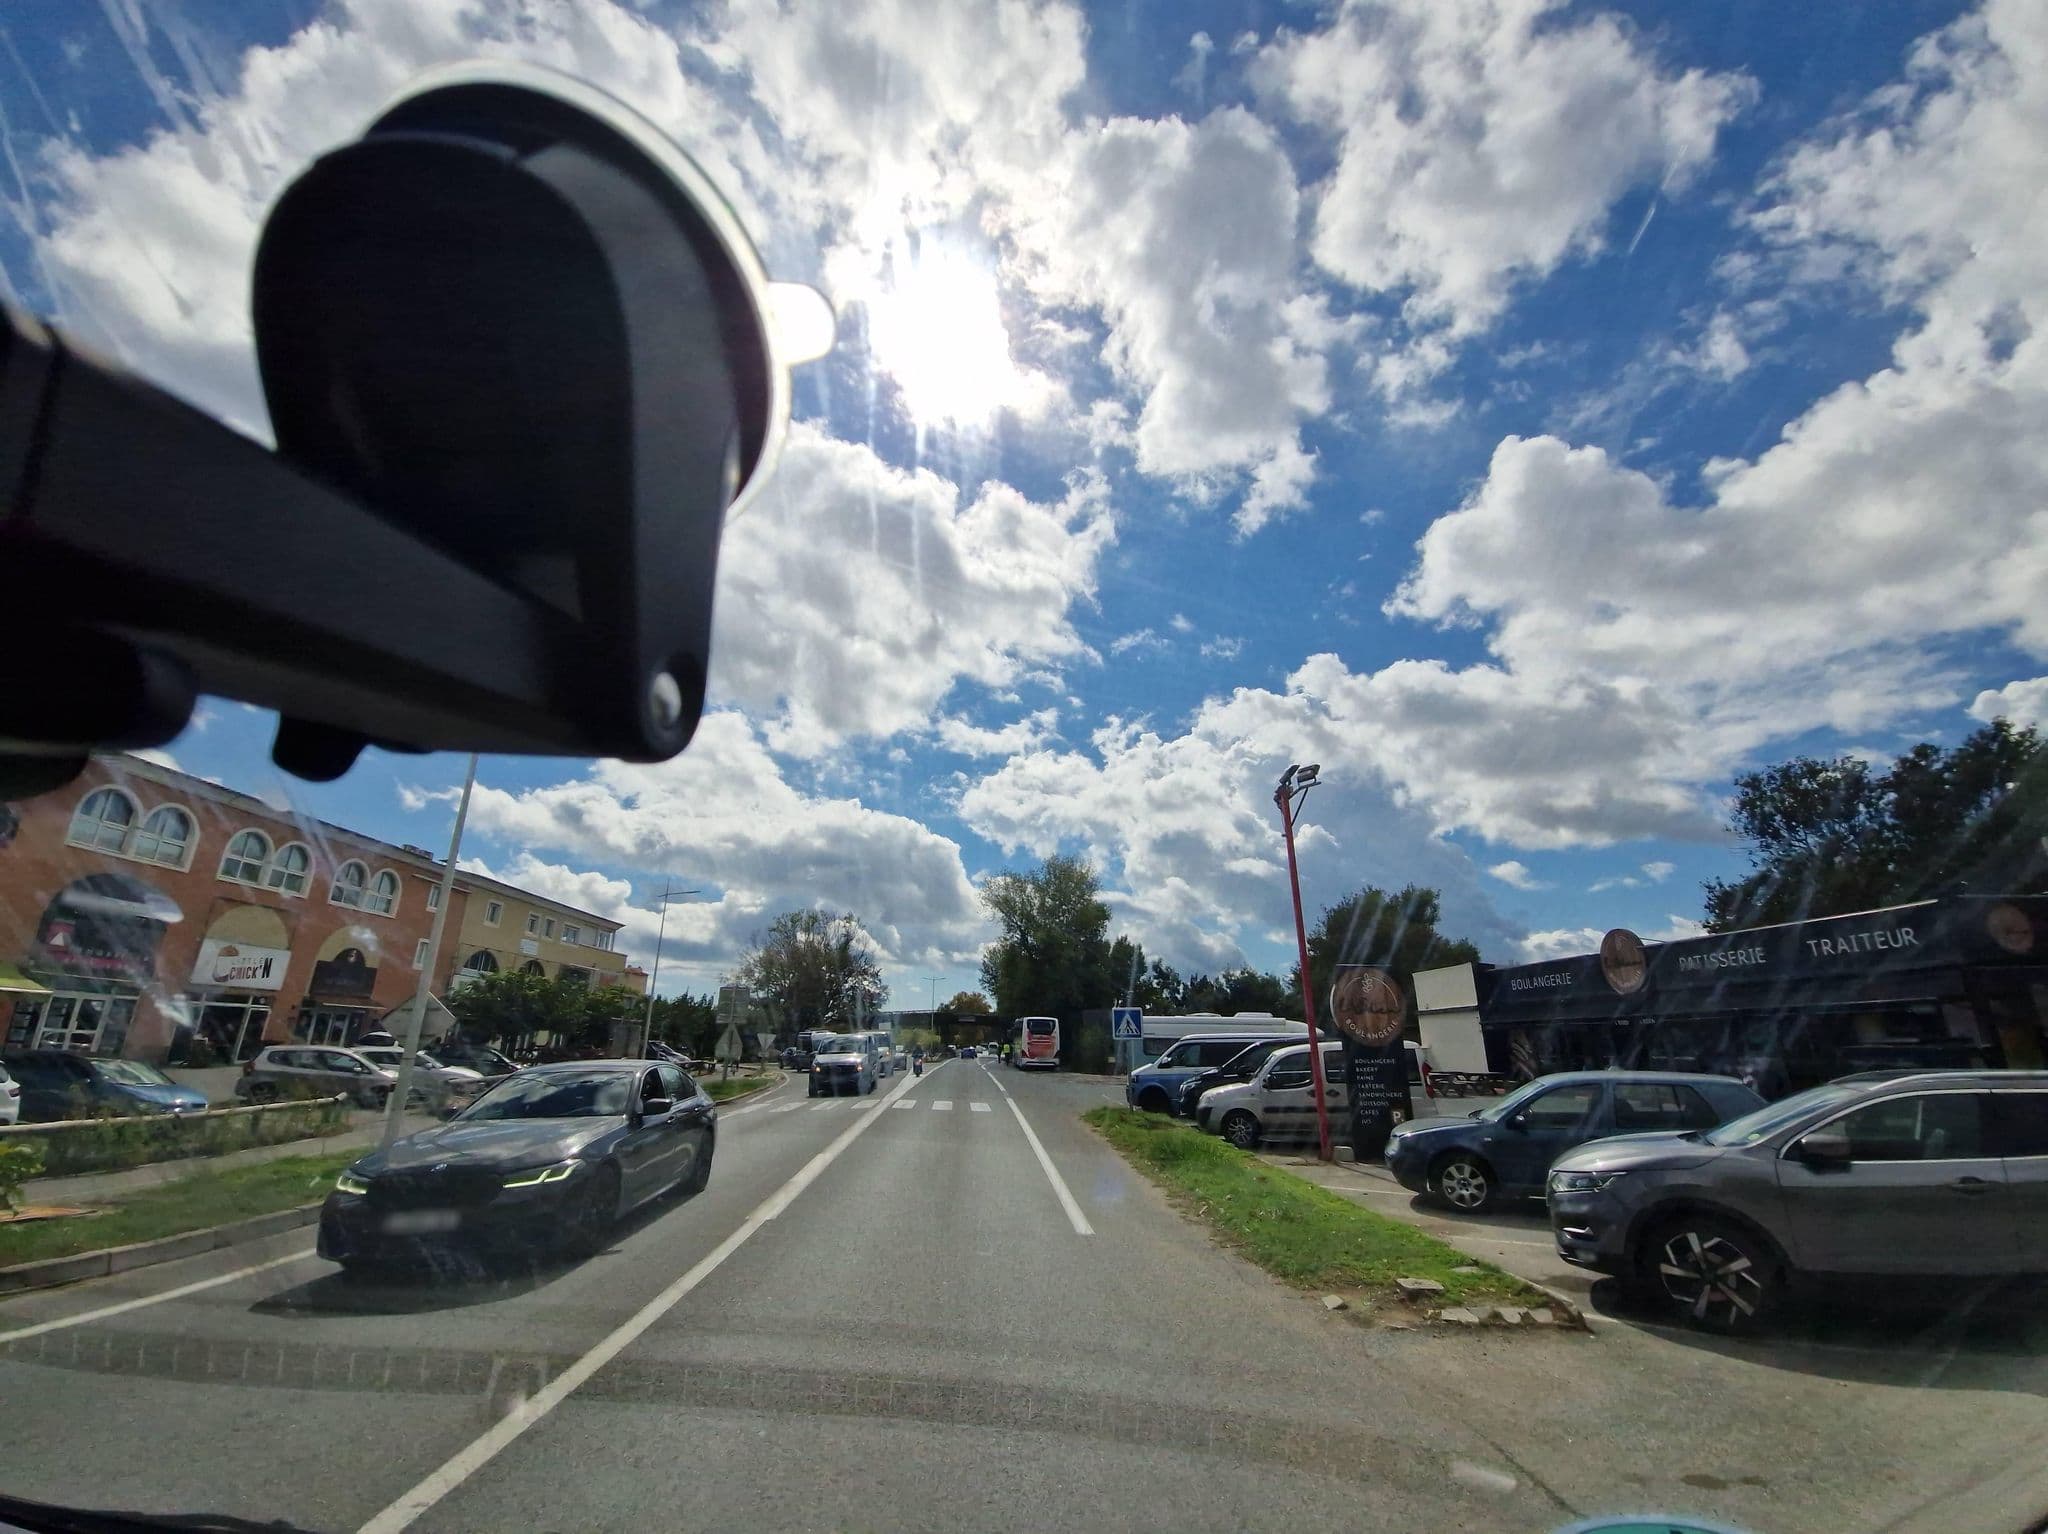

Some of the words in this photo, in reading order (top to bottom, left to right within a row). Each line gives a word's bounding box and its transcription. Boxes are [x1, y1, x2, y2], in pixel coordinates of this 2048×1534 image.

[1807, 927, 1919, 957] TRAITEUR
[230, 957, 273, 980] CHICK'N
[1511, 972, 1572, 991] BOULANGERIE
[1345, 1018, 1399, 1040] BOULANGERIE
